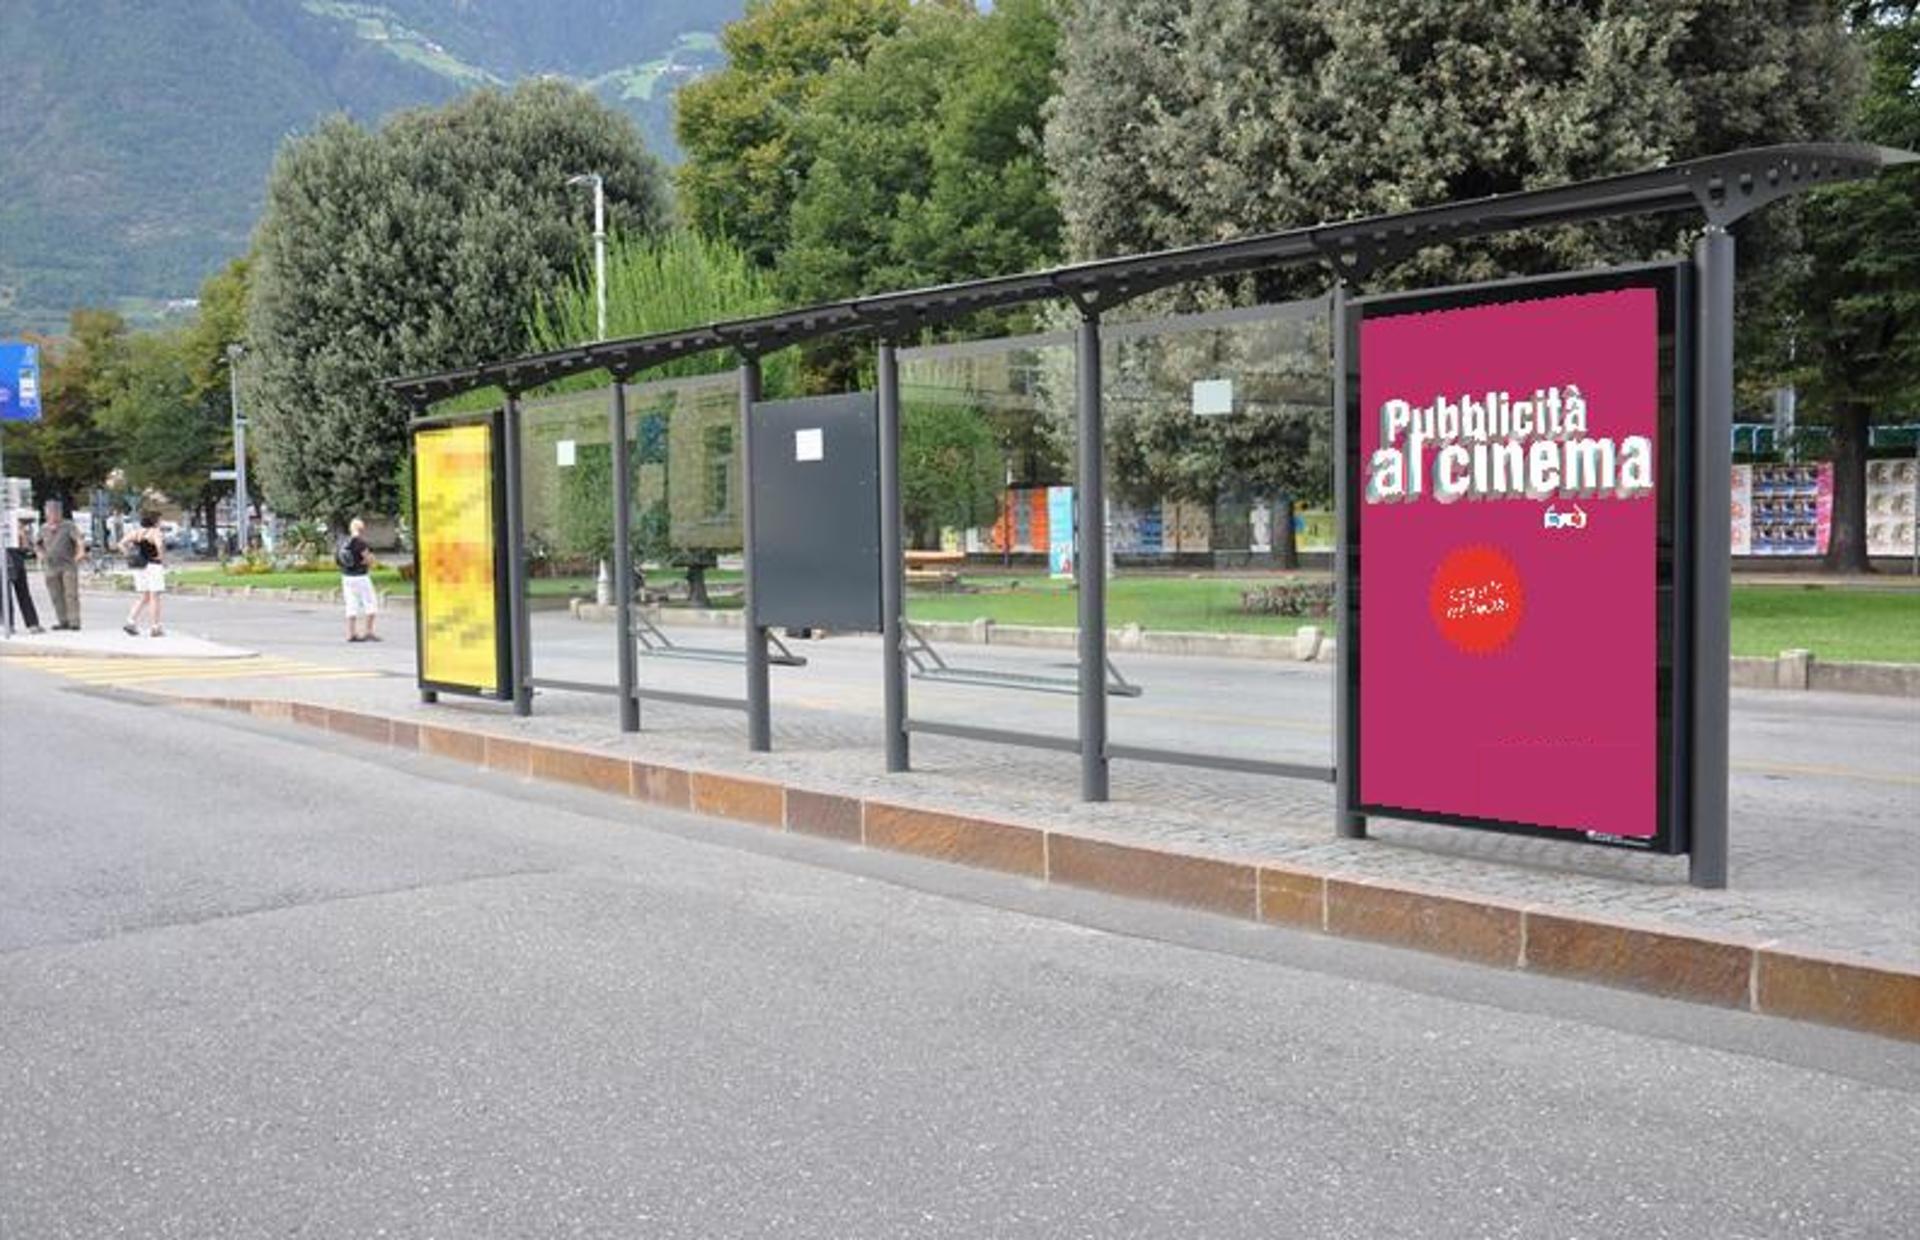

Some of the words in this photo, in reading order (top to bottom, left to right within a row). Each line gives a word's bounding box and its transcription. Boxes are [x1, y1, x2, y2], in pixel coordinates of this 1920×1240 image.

[1382, 384, 1588, 443] Pubblicità
[1367, 431, 1425, 502] al
[1434, 434, 1654, 501] cinema
